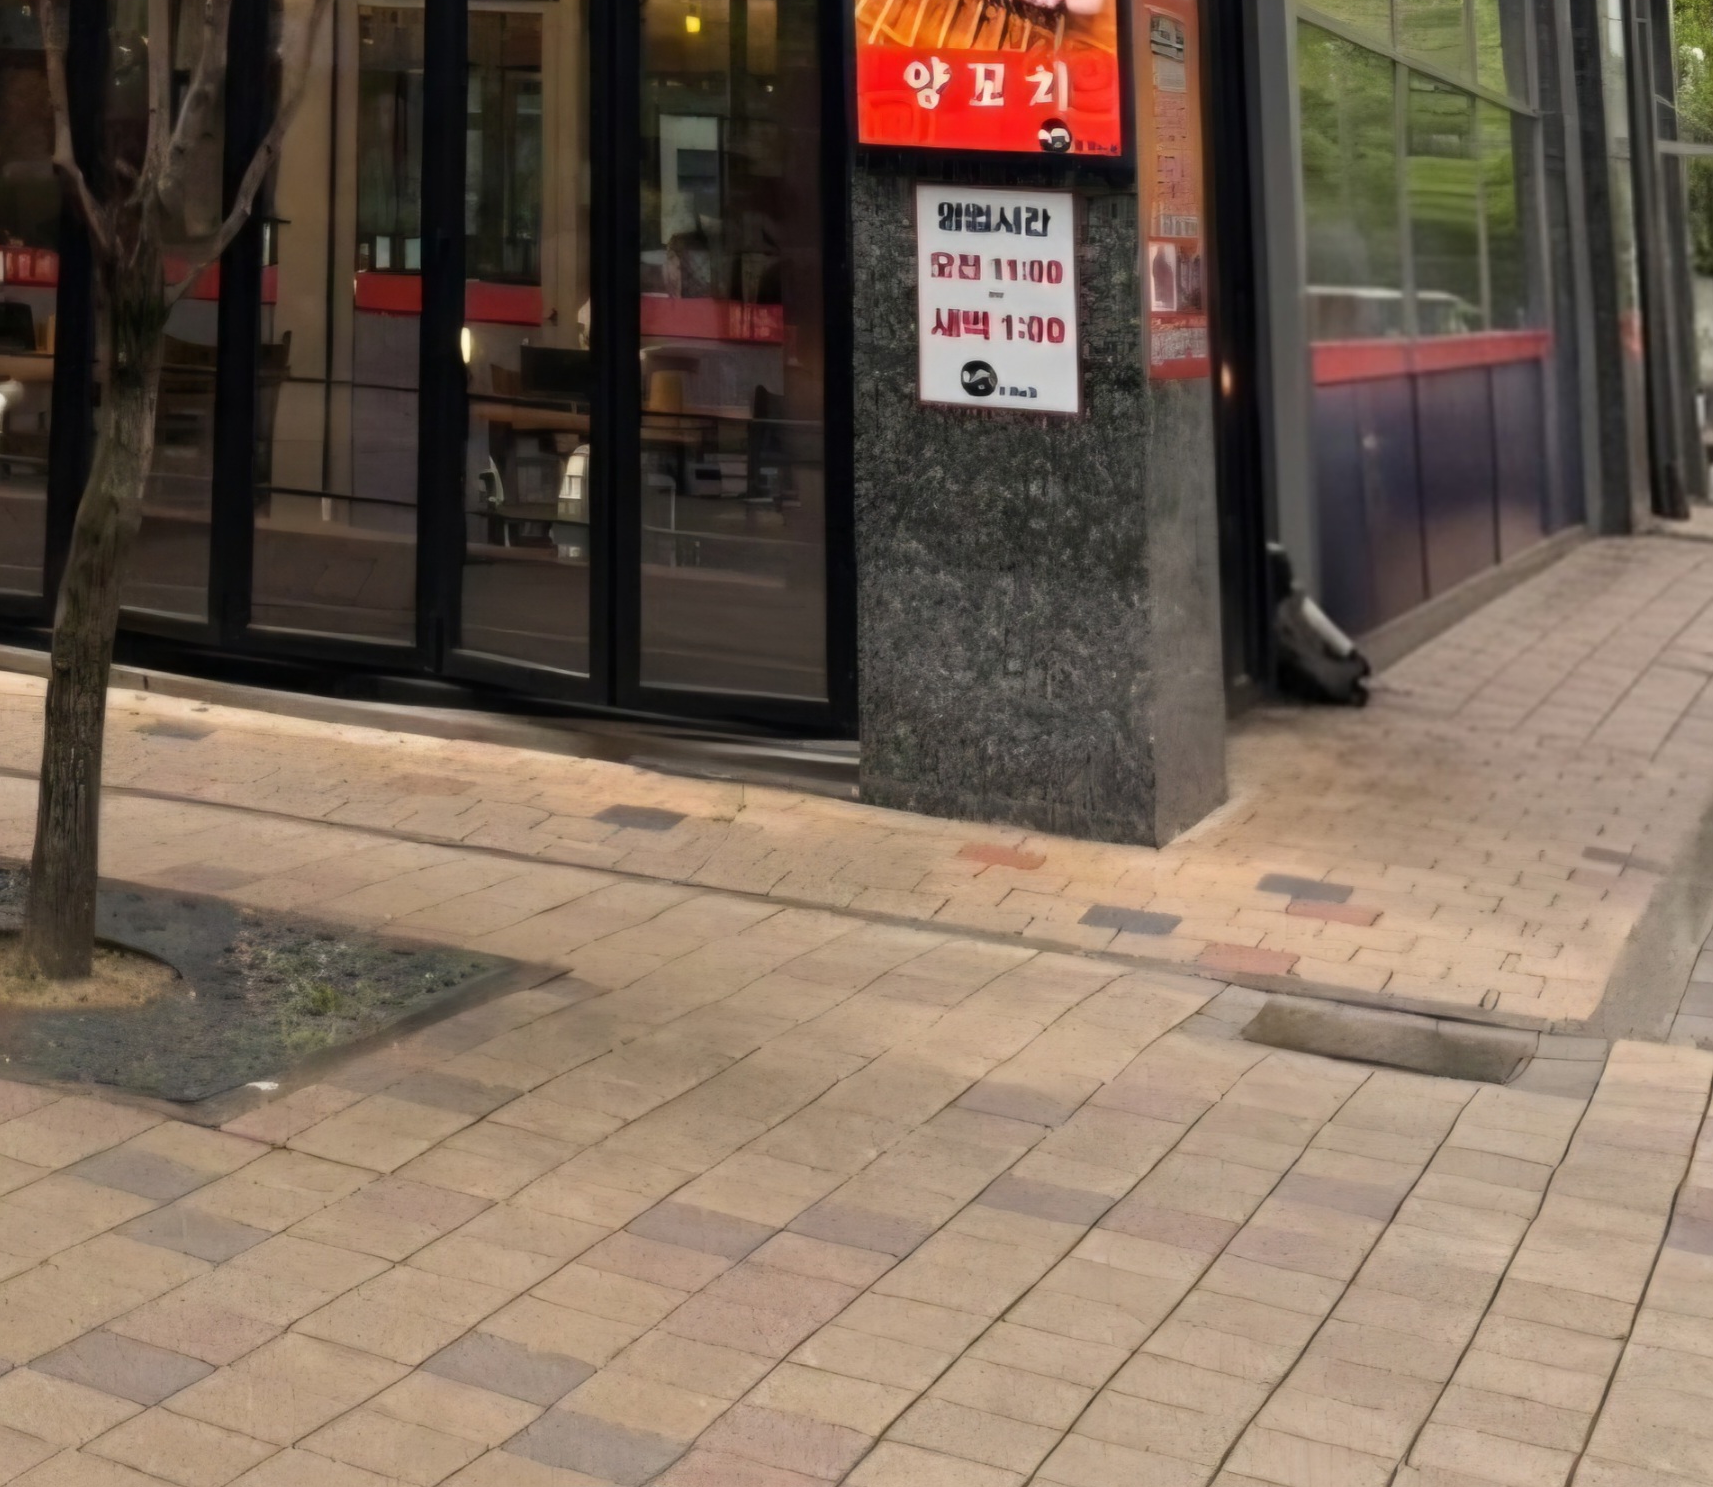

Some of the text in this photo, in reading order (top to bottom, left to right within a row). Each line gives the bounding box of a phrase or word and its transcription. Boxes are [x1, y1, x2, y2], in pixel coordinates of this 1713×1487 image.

[903, 56, 1069, 112] 양꼬치
[990, 258, 1064, 284] 11:00
[1001, 315, 1066, 344] 1:00
